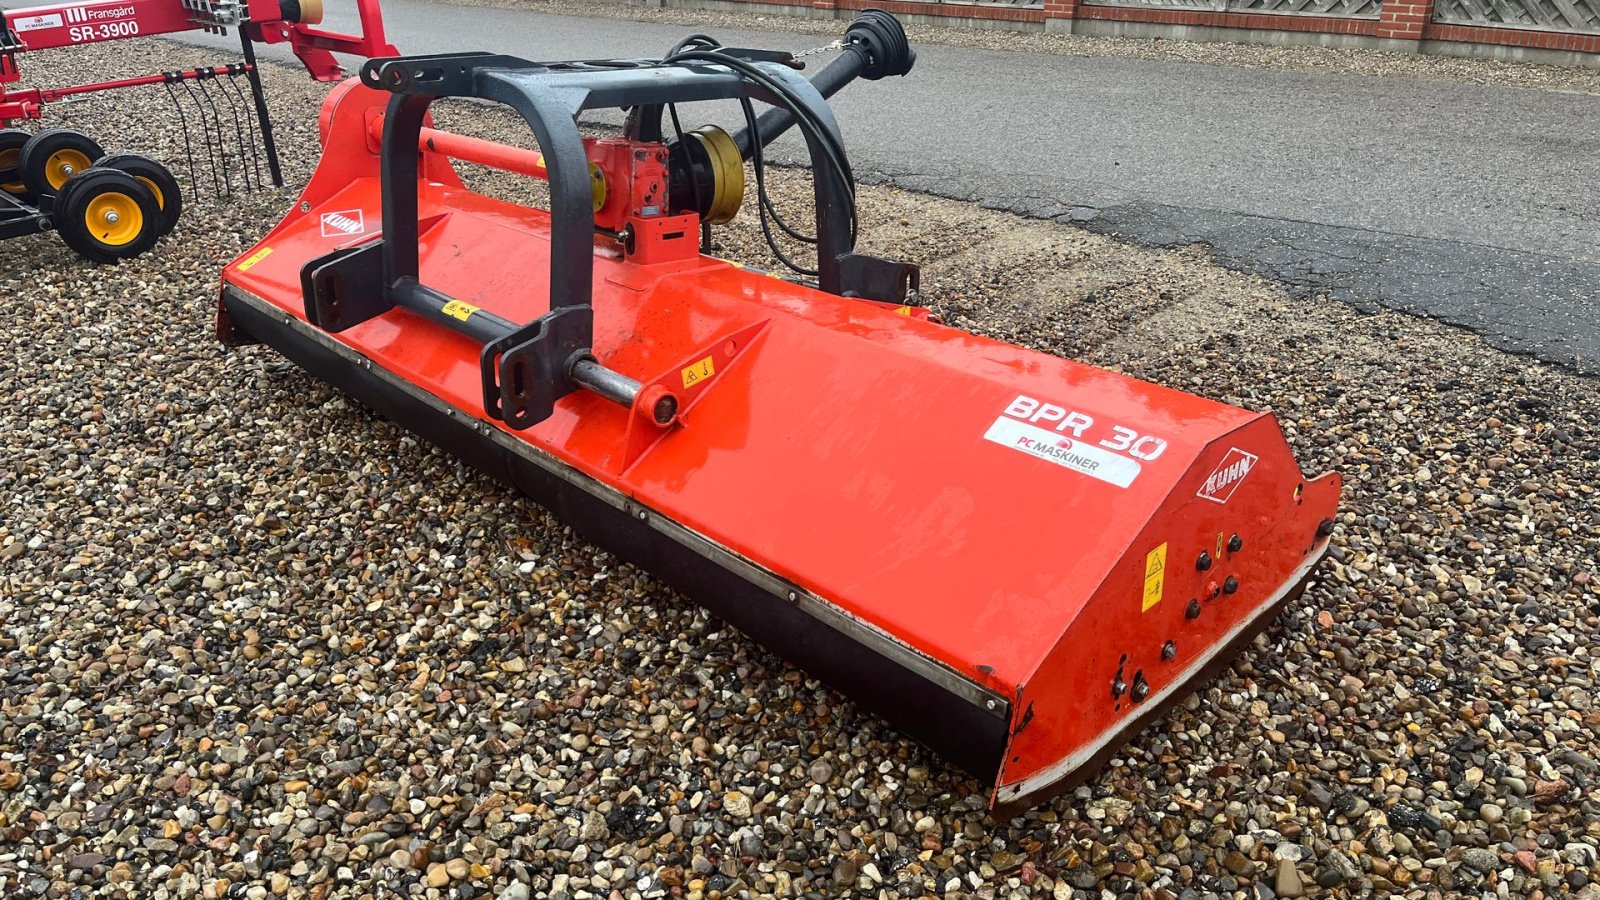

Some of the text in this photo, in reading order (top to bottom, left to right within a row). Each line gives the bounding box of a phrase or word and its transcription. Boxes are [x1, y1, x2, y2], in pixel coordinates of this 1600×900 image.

[87, 5, 135, 20] Fransgård
[69, 20, 139, 42] SR-3900
[323, 212, 362, 234] KUHN
[1003, 394, 1168, 461] BPR 30
[1017, 436, 1036, 448] PC
[1033, 442, 1100, 471] MASKINER
[1205, 454, 1251, 497] KUHN
